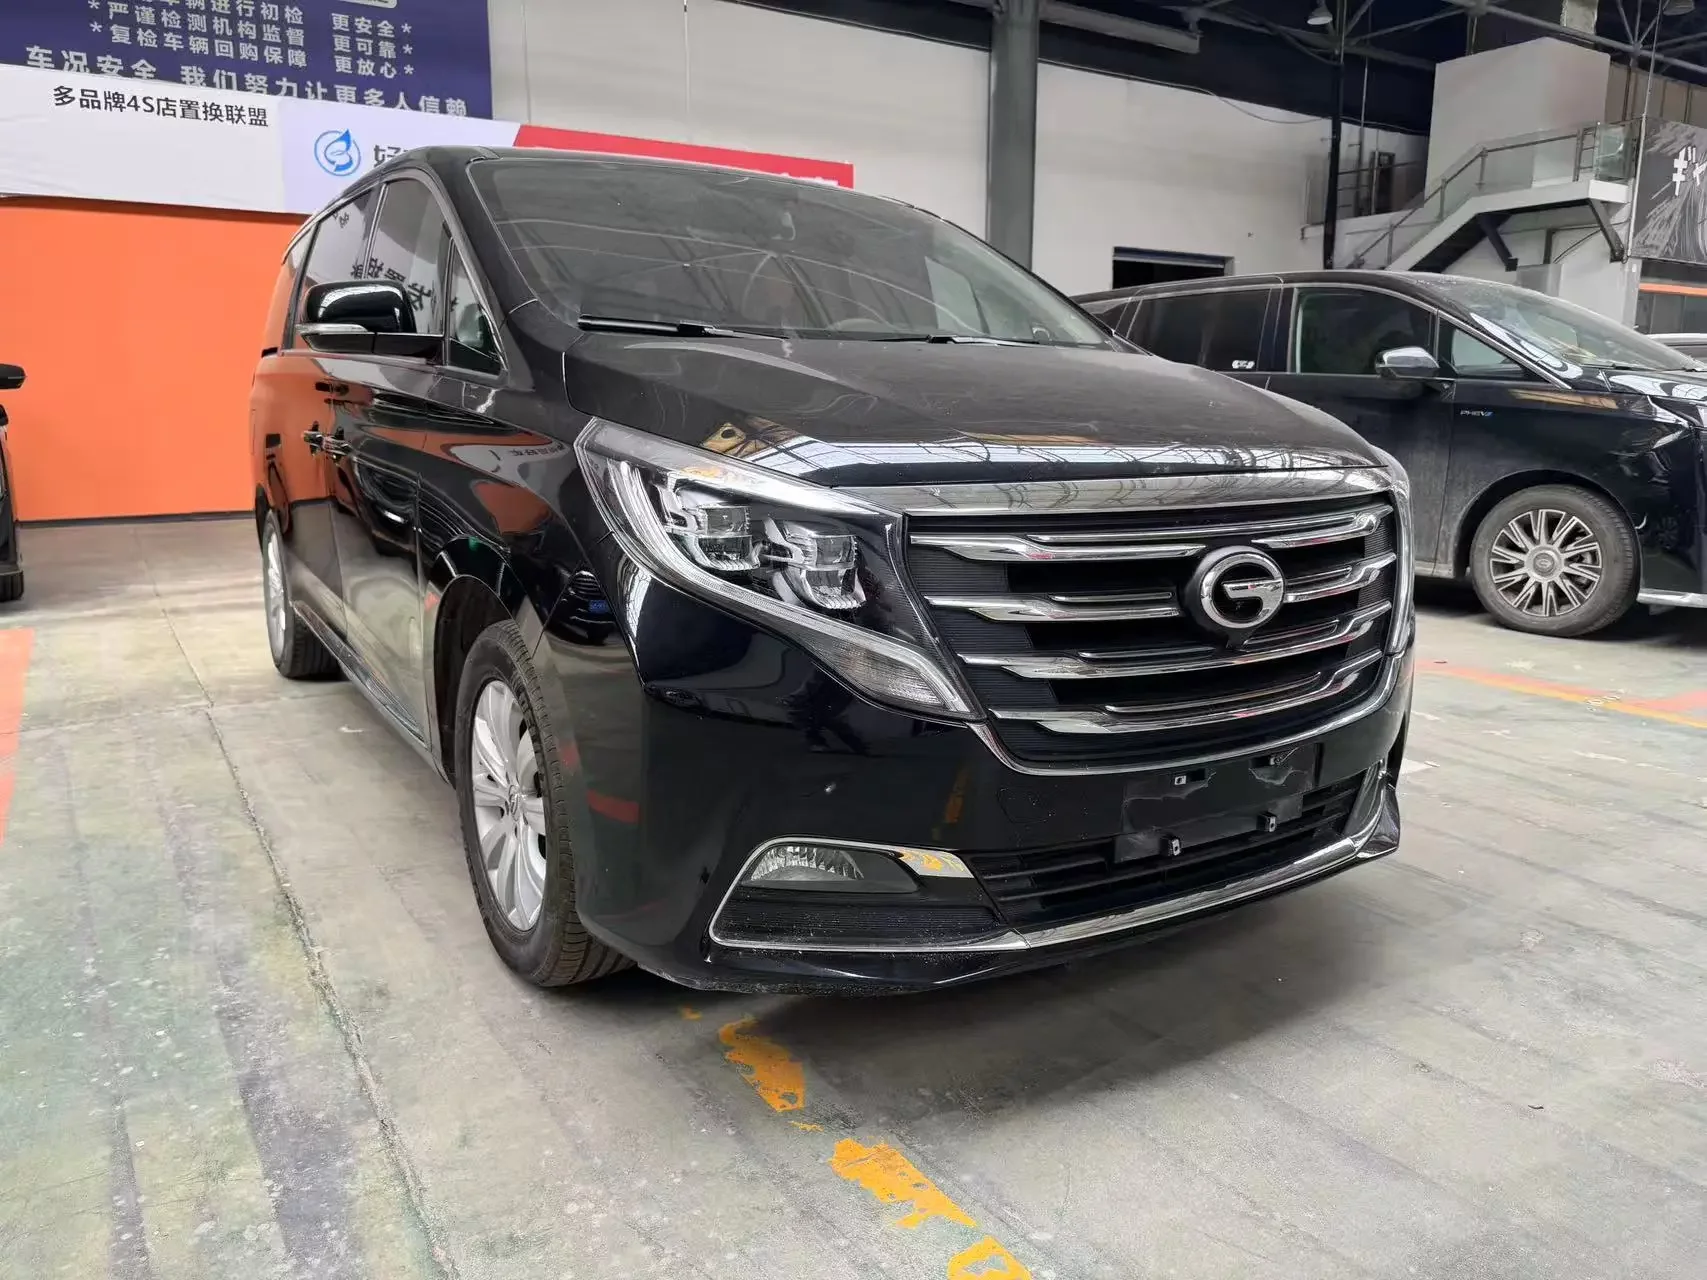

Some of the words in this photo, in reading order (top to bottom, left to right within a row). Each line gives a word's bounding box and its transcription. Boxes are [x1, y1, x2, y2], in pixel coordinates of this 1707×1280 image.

[108, 1, 305, 47] 严谨检测机构监督
[333, 34, 396, 59] 更可靠
[110, 24, 308, 69] 复检车辆回购保障
[334, 55, 397, 79] 更放心
[331, 12, 395, 38] 更安全
[26, 45, 159, 80] 车况安全
[180, 64, 468, 117] 我们努力让更多人信赖
[53, 85, 269, 127] 多品牌4S店置换联盟
